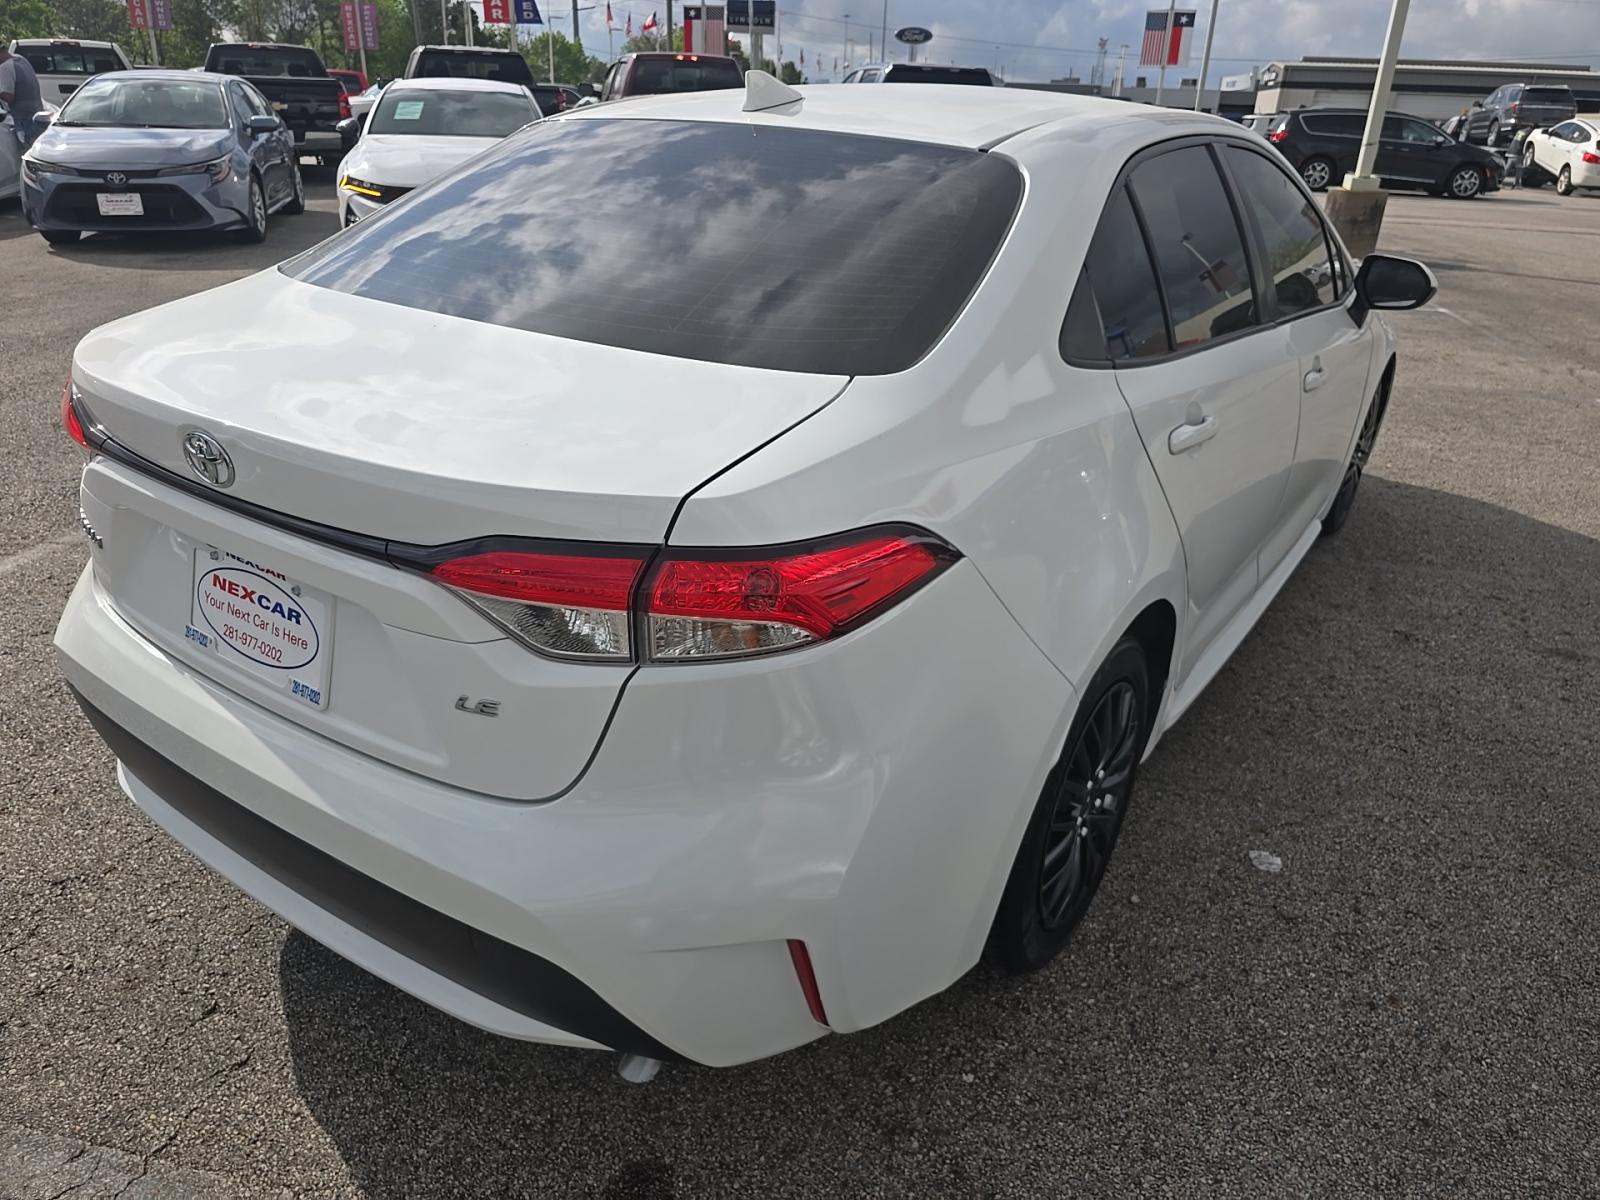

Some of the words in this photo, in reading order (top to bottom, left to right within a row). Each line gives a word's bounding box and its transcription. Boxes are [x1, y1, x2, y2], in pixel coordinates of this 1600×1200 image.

[729, 16, 772, 25] LINOLN
[902, 30, 926, 41] Ford
[212, 573, 302, 626] NEXCAR
[204, 590, 225, 611] Your
[227, 601, 251, 624] Next
[253, 613, 270, 631] Car
[283, 627, 309, 650] Here
[223, 623, 283, 664] 281-977-0202
[455, 694, 501, 717] LE
